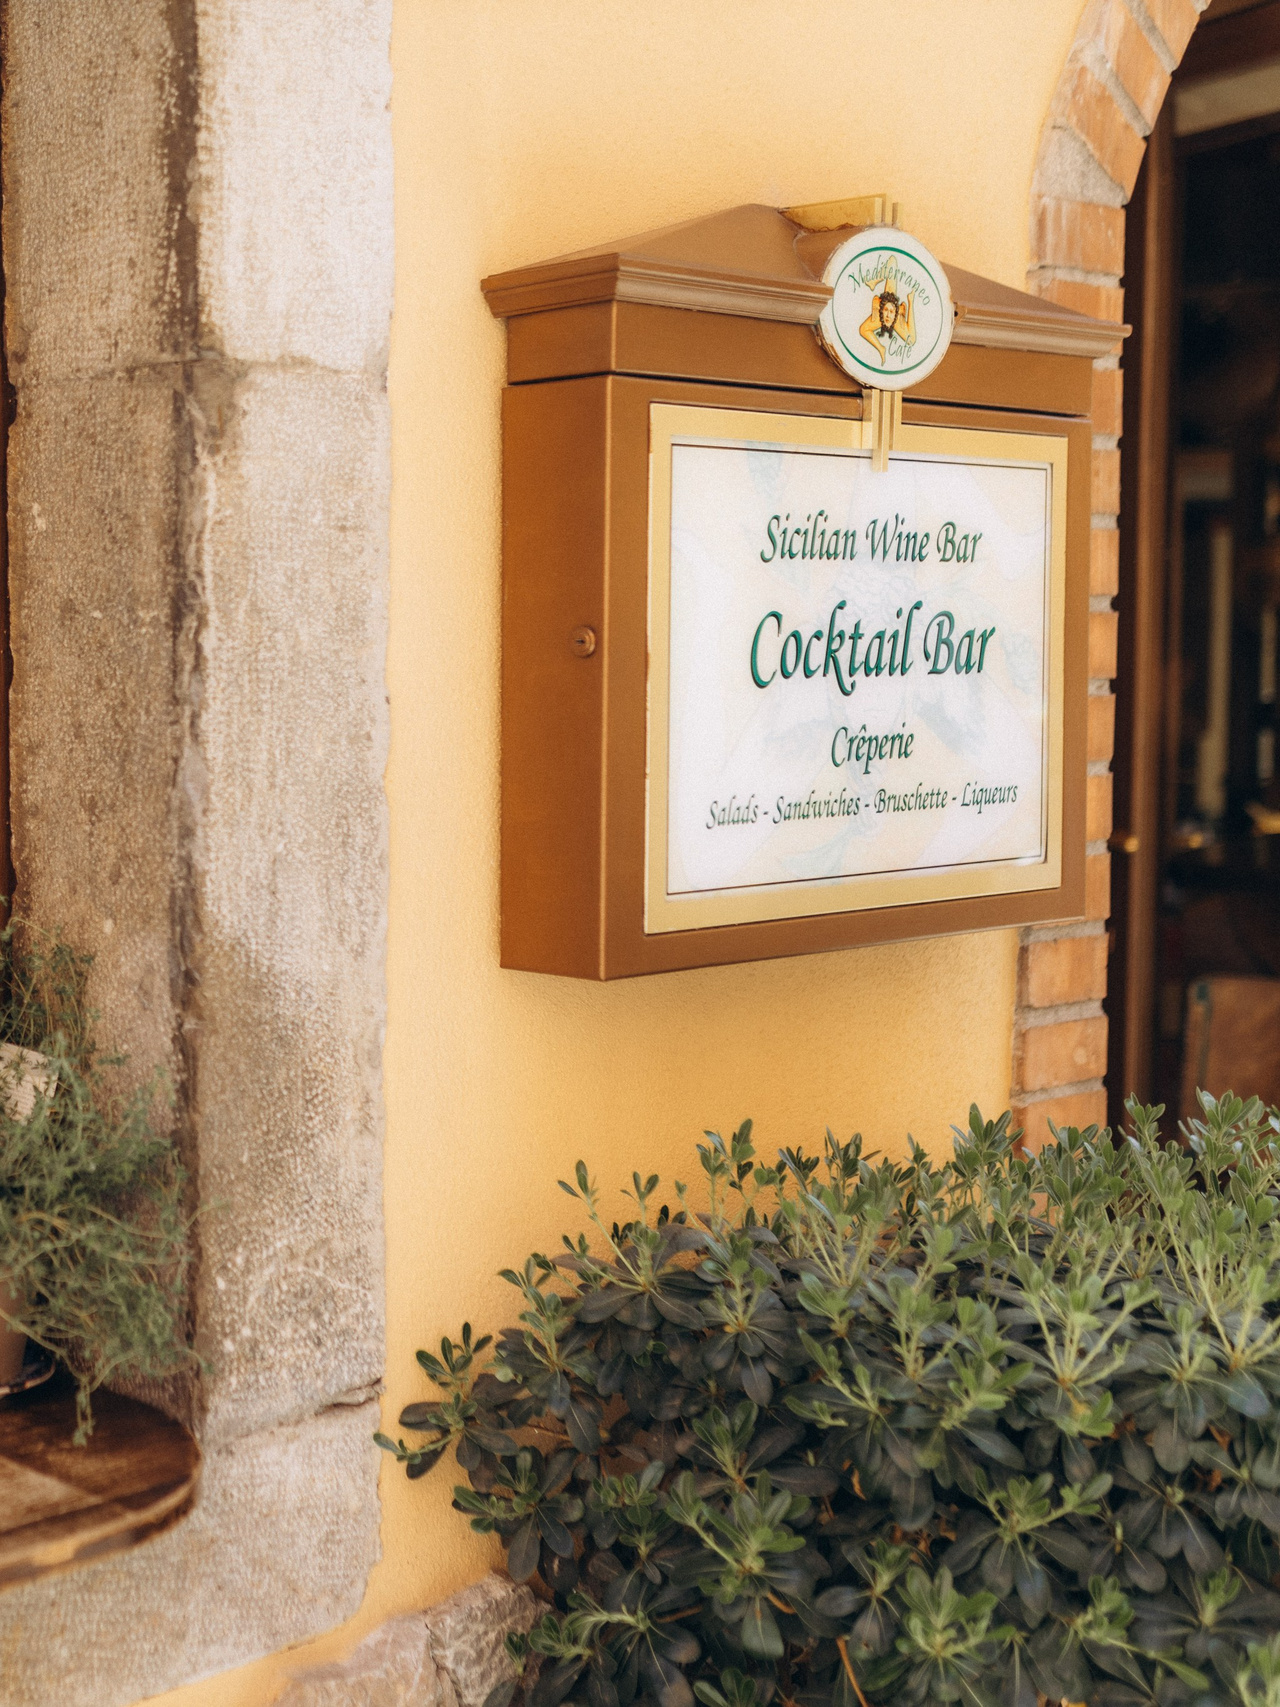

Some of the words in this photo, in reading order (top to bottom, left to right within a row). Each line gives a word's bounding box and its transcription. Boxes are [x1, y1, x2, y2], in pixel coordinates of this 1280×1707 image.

[848, 254, 931, 306] Mediterraneo
[760, 509, 857, 563] Sicilian
[866, 513, 930, 562] Wine
[936, 521, 983, 563] Bar
[750, 600, 923, 696] Cocktail
[923, 610, 996, 675] Bar
[831, 722, 914, 775] Crêperie
[705, 794, 759, 830] Salads
[773, 790, 861, 824] Sandwiches
[874, 782, 948, 813] Bruschette
[961, 781, 1018, 815] Liqueurs
